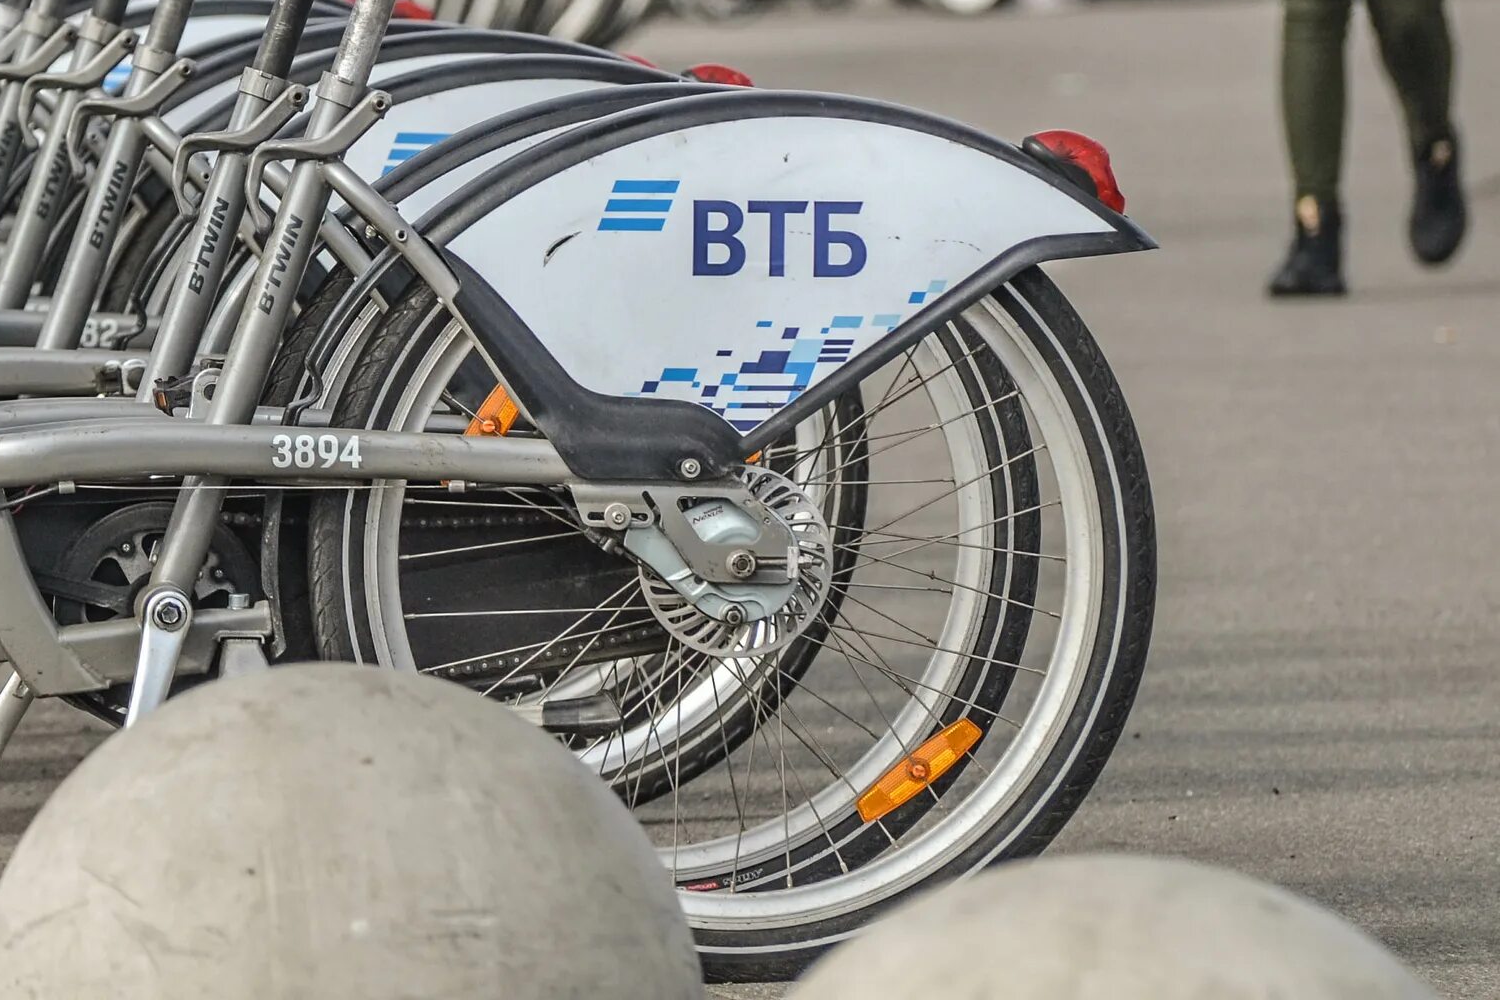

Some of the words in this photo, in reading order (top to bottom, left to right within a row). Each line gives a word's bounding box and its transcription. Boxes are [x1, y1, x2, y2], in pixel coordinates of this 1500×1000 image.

[88, 160, 130, 251] B'TWIN
[187, 195, 231, 296] B'TWIN
[692, 199, 868, 278] ВТБ
[257, 213, 305, 317] B'TWIN
[271, 434, 363, 470] 3894
